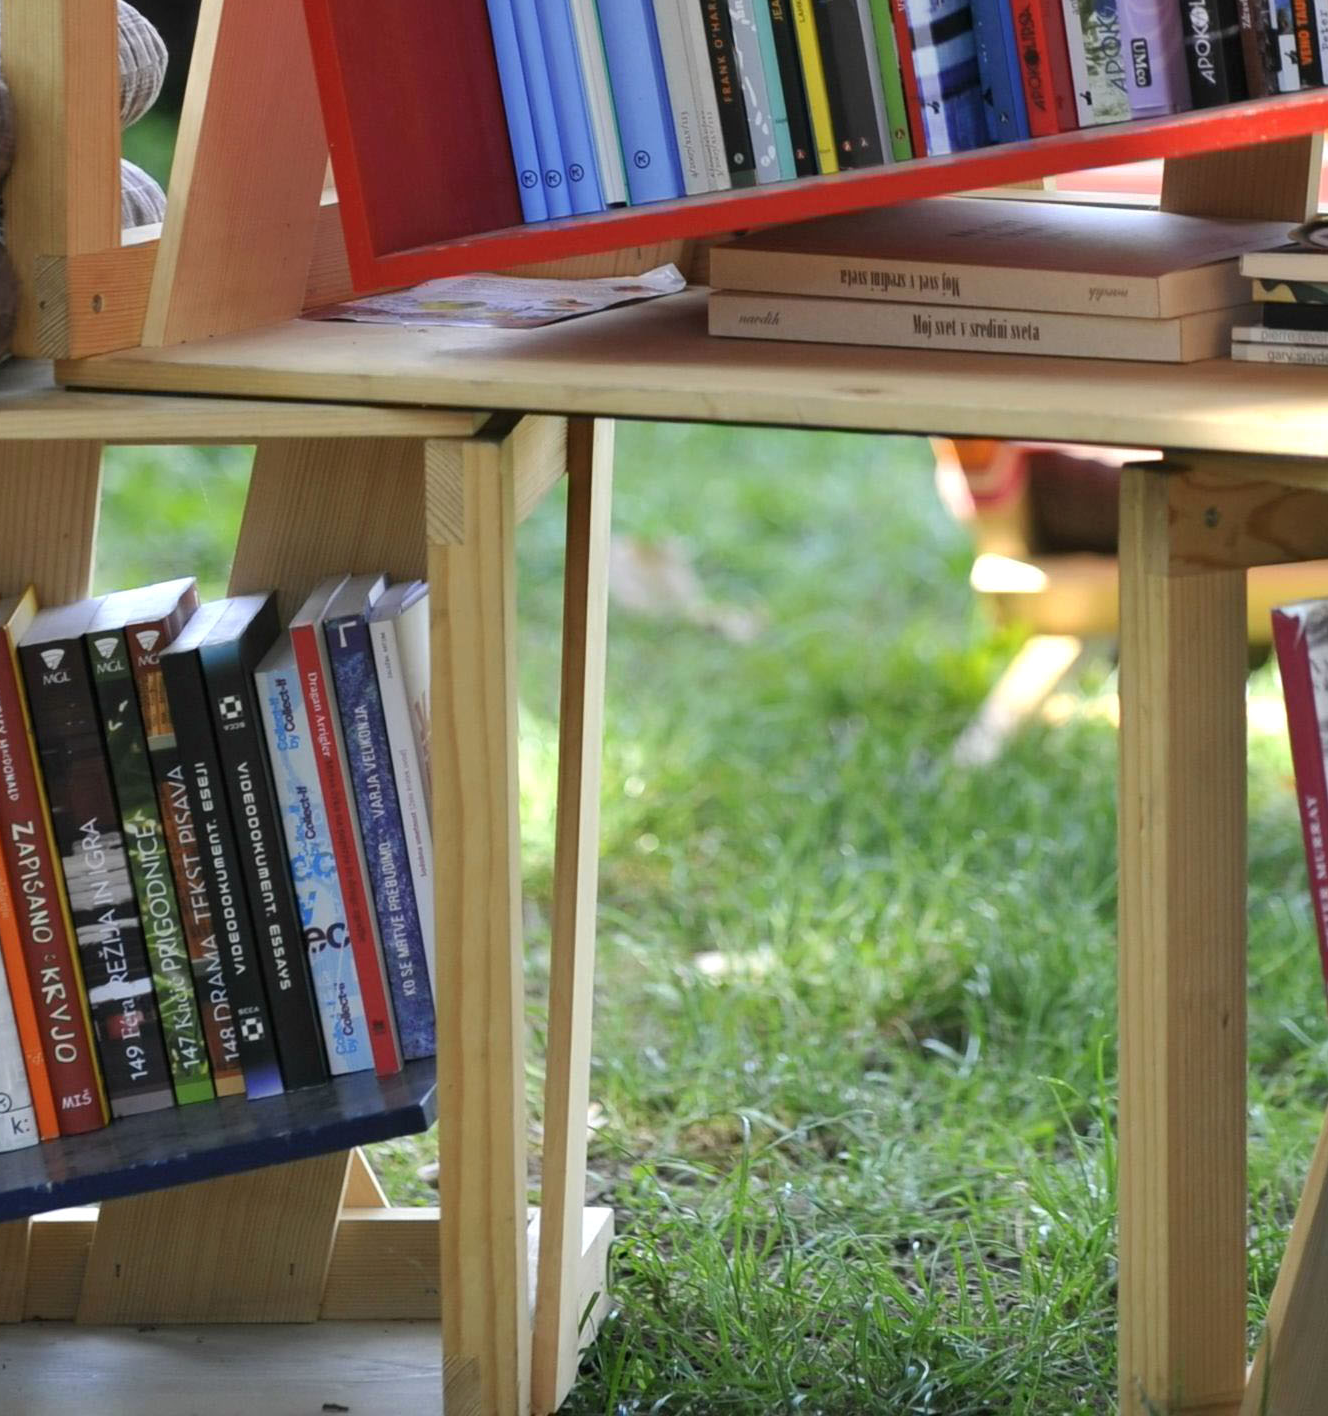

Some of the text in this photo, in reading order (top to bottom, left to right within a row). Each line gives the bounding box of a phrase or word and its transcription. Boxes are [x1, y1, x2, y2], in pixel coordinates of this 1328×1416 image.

[1130, 38, 1150, 87] UMco
[1296, 29, 1313, 65] VENO
[715, 54, 734, 103] FRANK
[839, 268, 869, 287] sveta
[868, 270, 907, 291] sredini
[917, 274, 940, 293] svet
[940, 276, 962, 298] Moj
[912, 313, 933, 338] Moj
[934, 315, 957, 337] svet
[968, 316, 1008, 340] sredini
[1009, 320, 1041, 343] sveta
[42, 671, 72, 685] MGL
[96, 662, 125, 675] MGL
[303, 670, 334, 759] Dragan Arrigler
[192, 760, 248, 975] VIDEODOKUMENT. ESEJI
[233, 760, 293, 992] VIDEODOKUMENT. ESSAYS
[131, 823, 183, 972] PRIGODNICE
[163, 764, 241, 1062] 148 DRAMA TEKST PISAVA
[177, 1032, 203, 1069] 147
